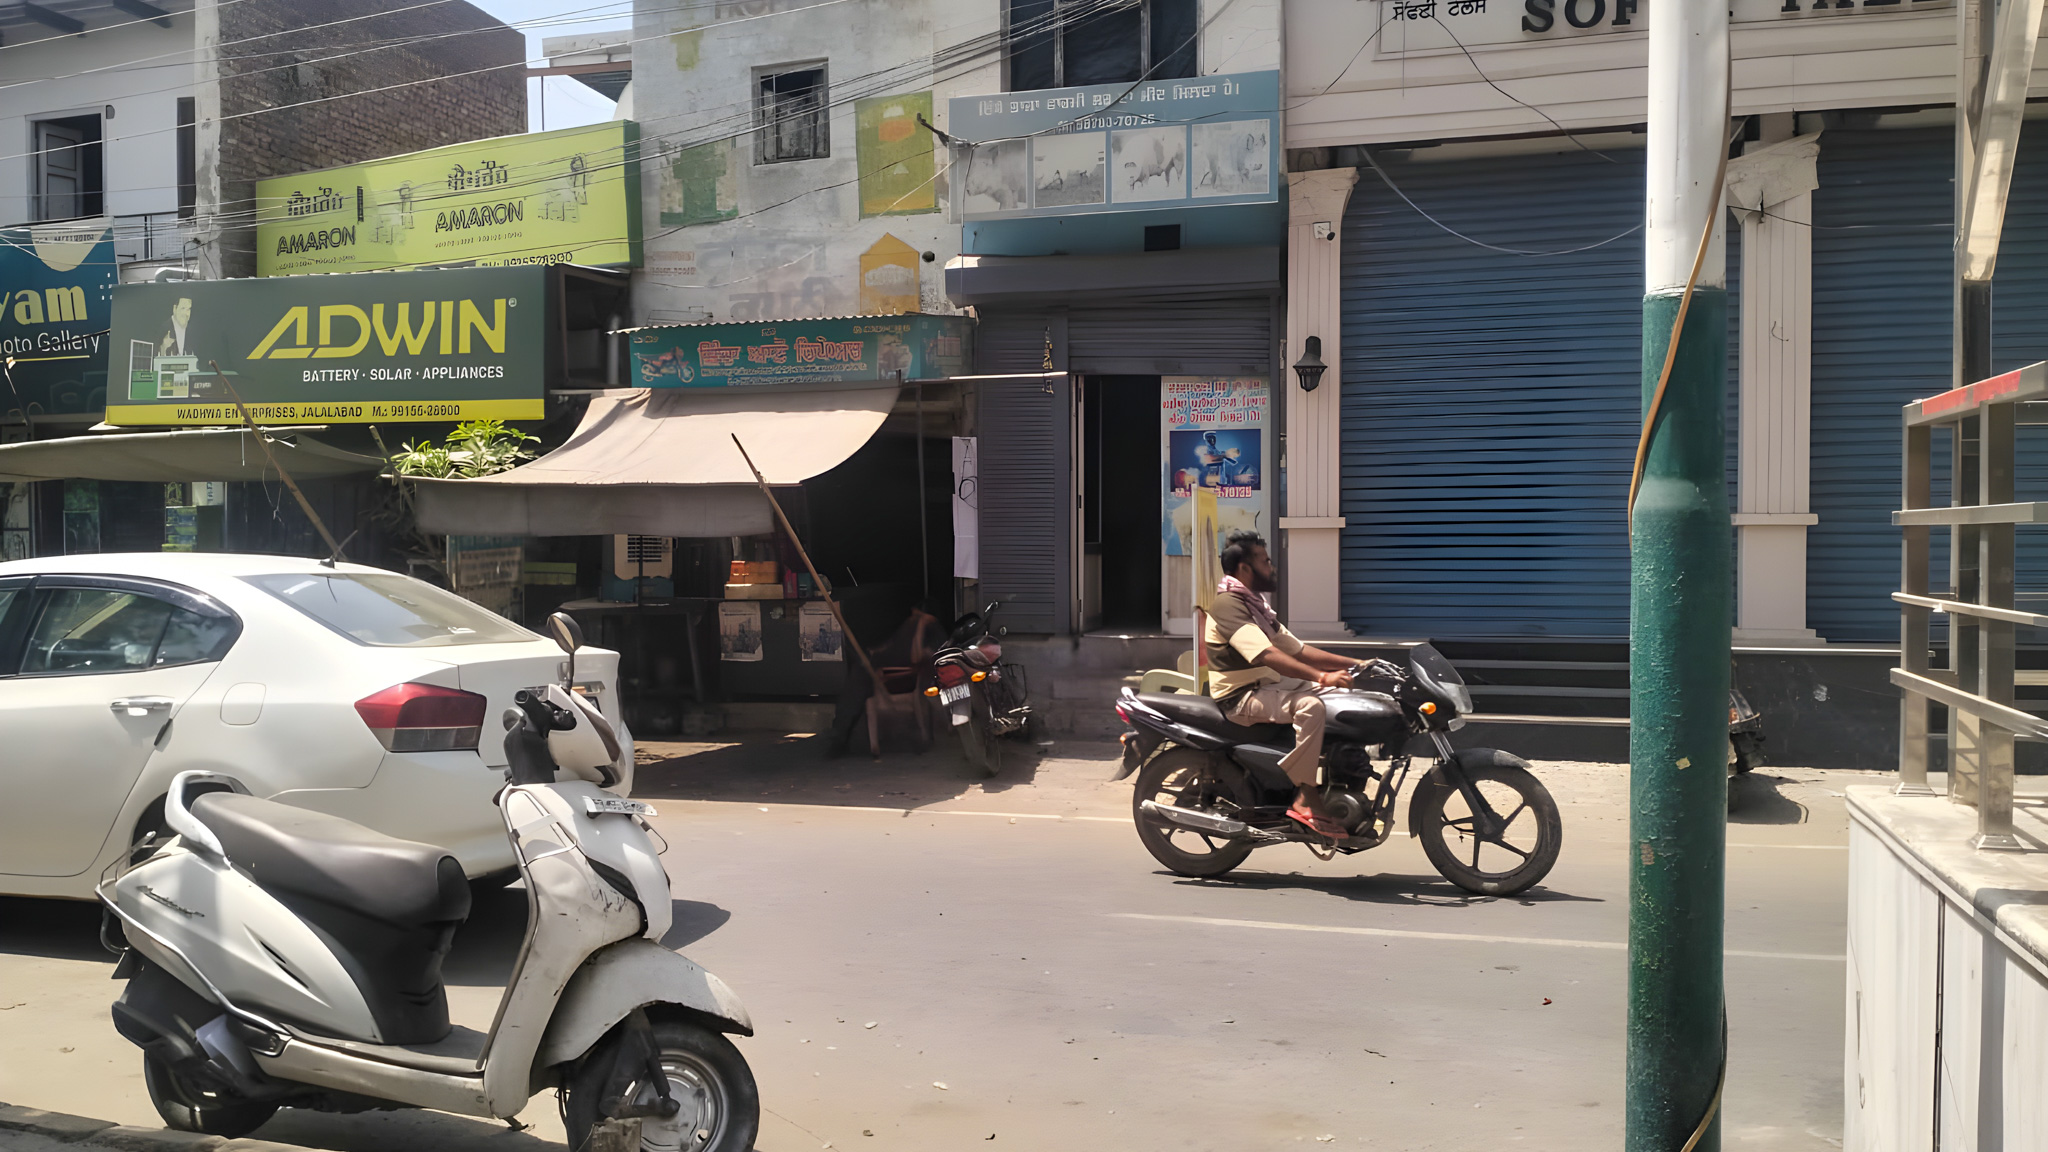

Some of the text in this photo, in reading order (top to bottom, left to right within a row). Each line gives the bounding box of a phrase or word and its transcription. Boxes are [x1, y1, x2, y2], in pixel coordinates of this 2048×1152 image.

[1521, 0, 1638, 32] SOF
[435, 200, 524, 233] AMARON
[276, 225, 356, 256] AMARON
[246, 298, 507, 360] ADWIN
[302, 366, 504, 382] BATTERY SOLAR APPLIANCES
